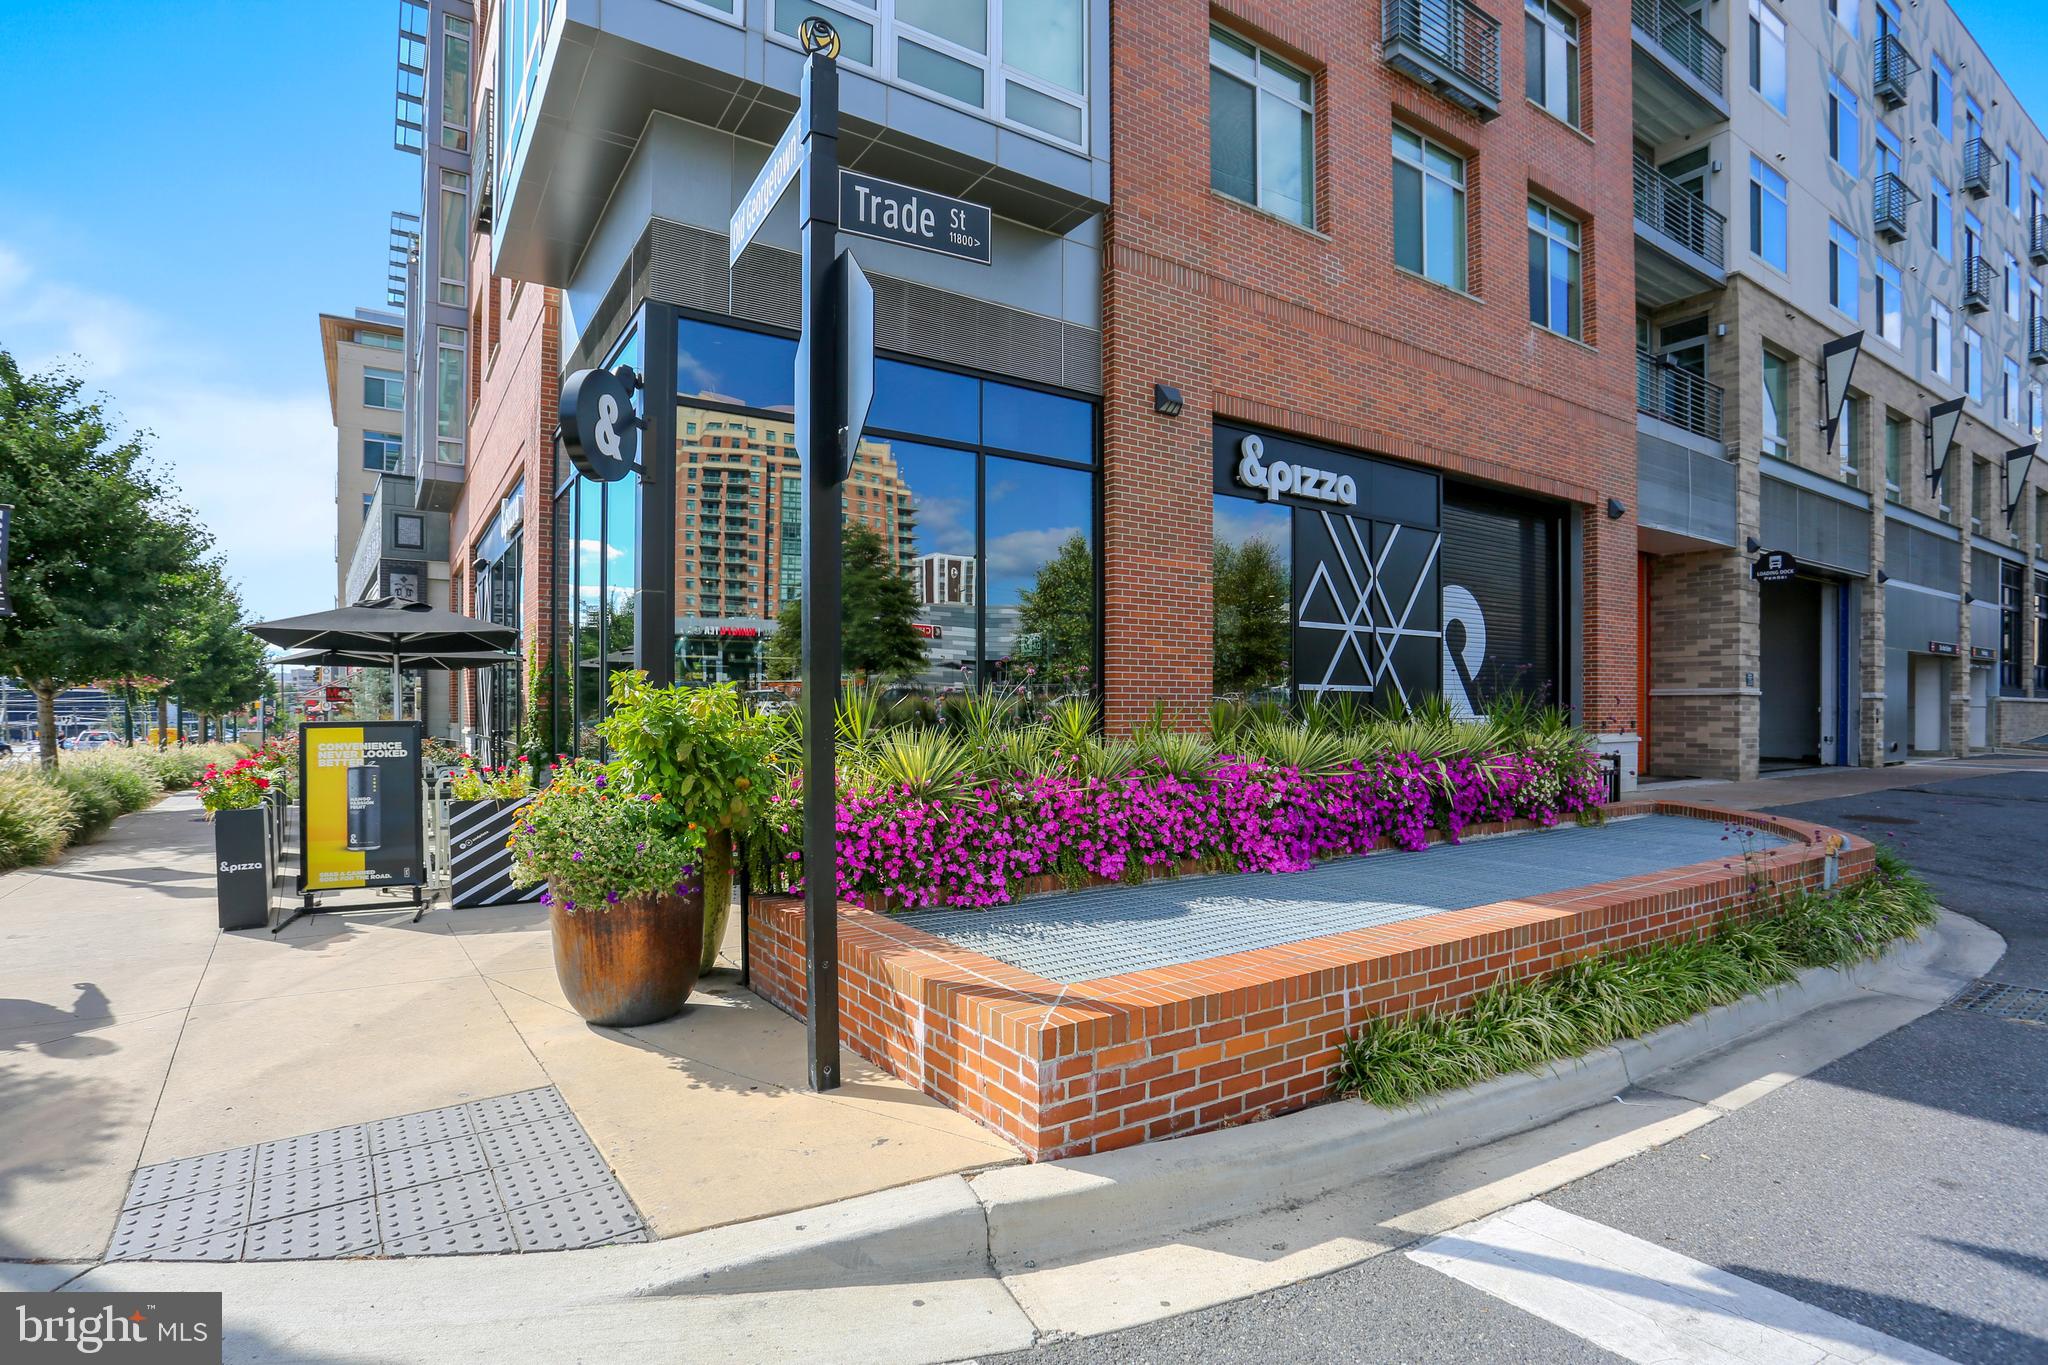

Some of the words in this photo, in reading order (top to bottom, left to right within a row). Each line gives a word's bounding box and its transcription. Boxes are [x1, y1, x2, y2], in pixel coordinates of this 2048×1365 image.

[733, 207, 745, 251] Old
[746, 135, 797, 230] Georgetown
[855, 185, 935, 238] Trade
[950, 208, 966, 231] St
[318, 742, 402, 751] CONVENIENCE
[318, 751, 358, 759] NEVER
[362, 750, 408, 758] LOOKED
[318, 759, 364, 768] BETTER
[220, 861, 263, 873] &pizza
